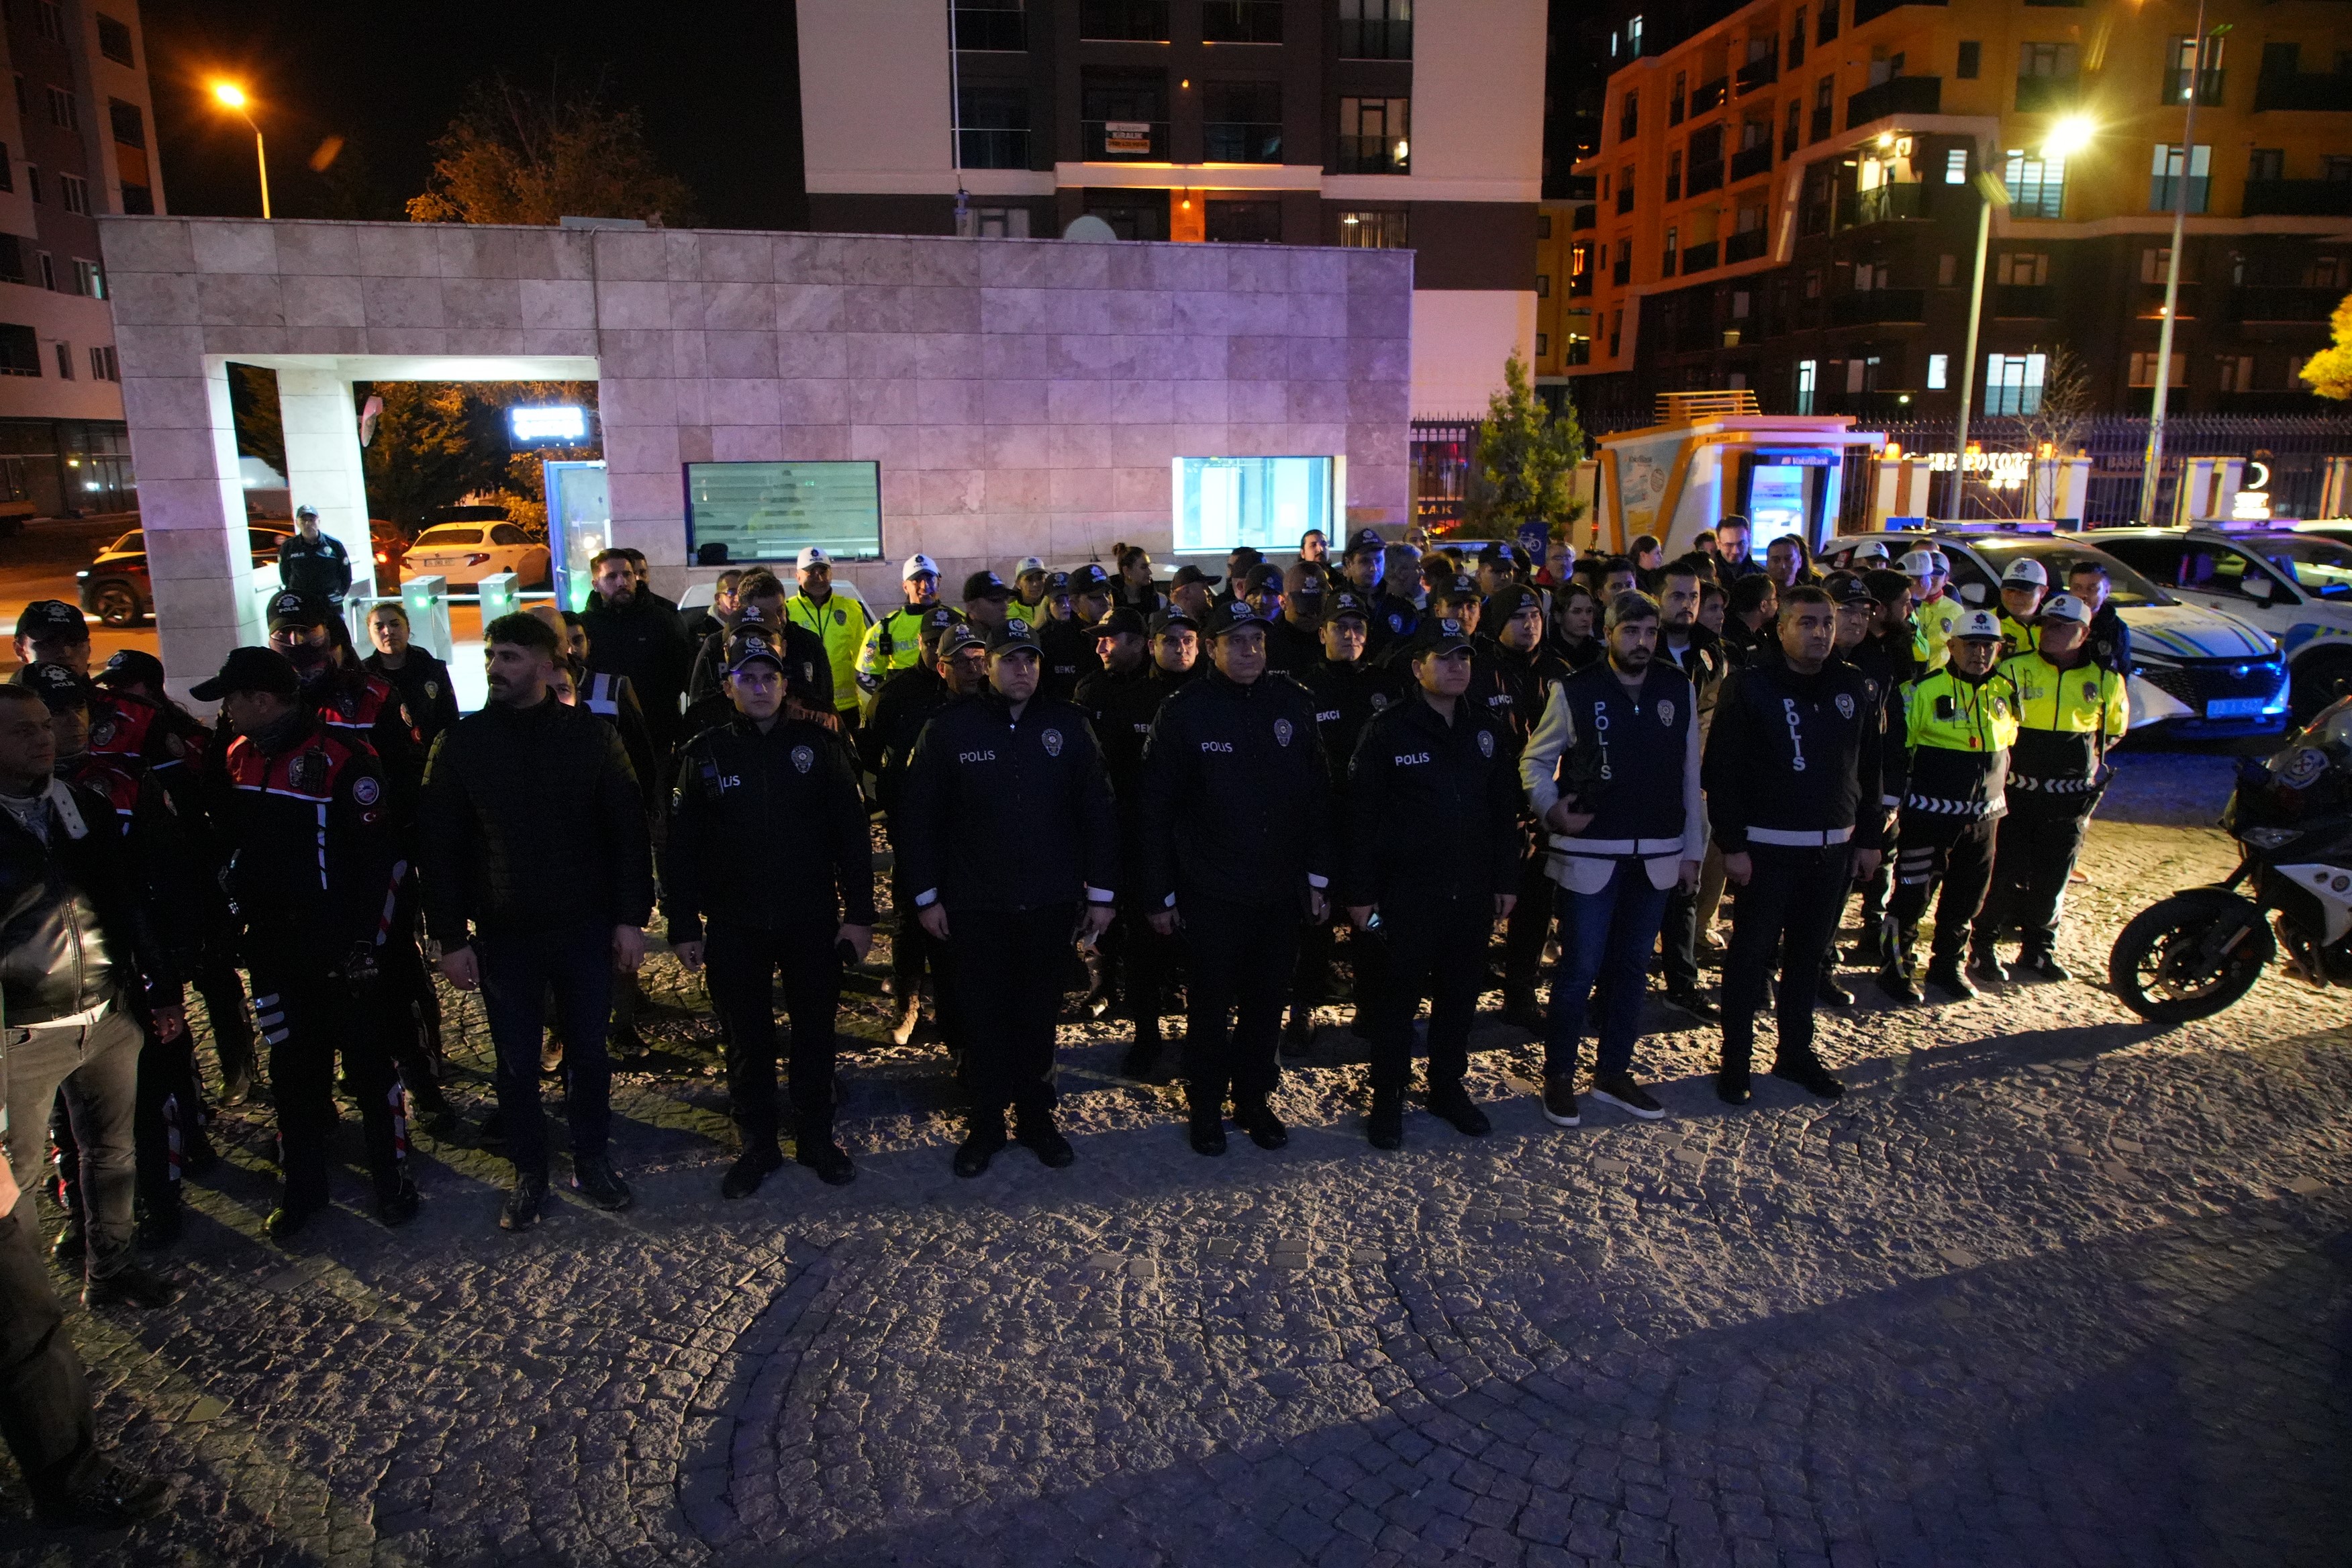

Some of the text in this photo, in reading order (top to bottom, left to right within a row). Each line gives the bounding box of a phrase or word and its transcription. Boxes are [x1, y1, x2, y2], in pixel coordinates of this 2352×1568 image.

[1055, 665, 1075, 674] BEKÇ
[1316, 710, 1340, 722] EKÇİ
[723, 775, 741, 787] LİS
